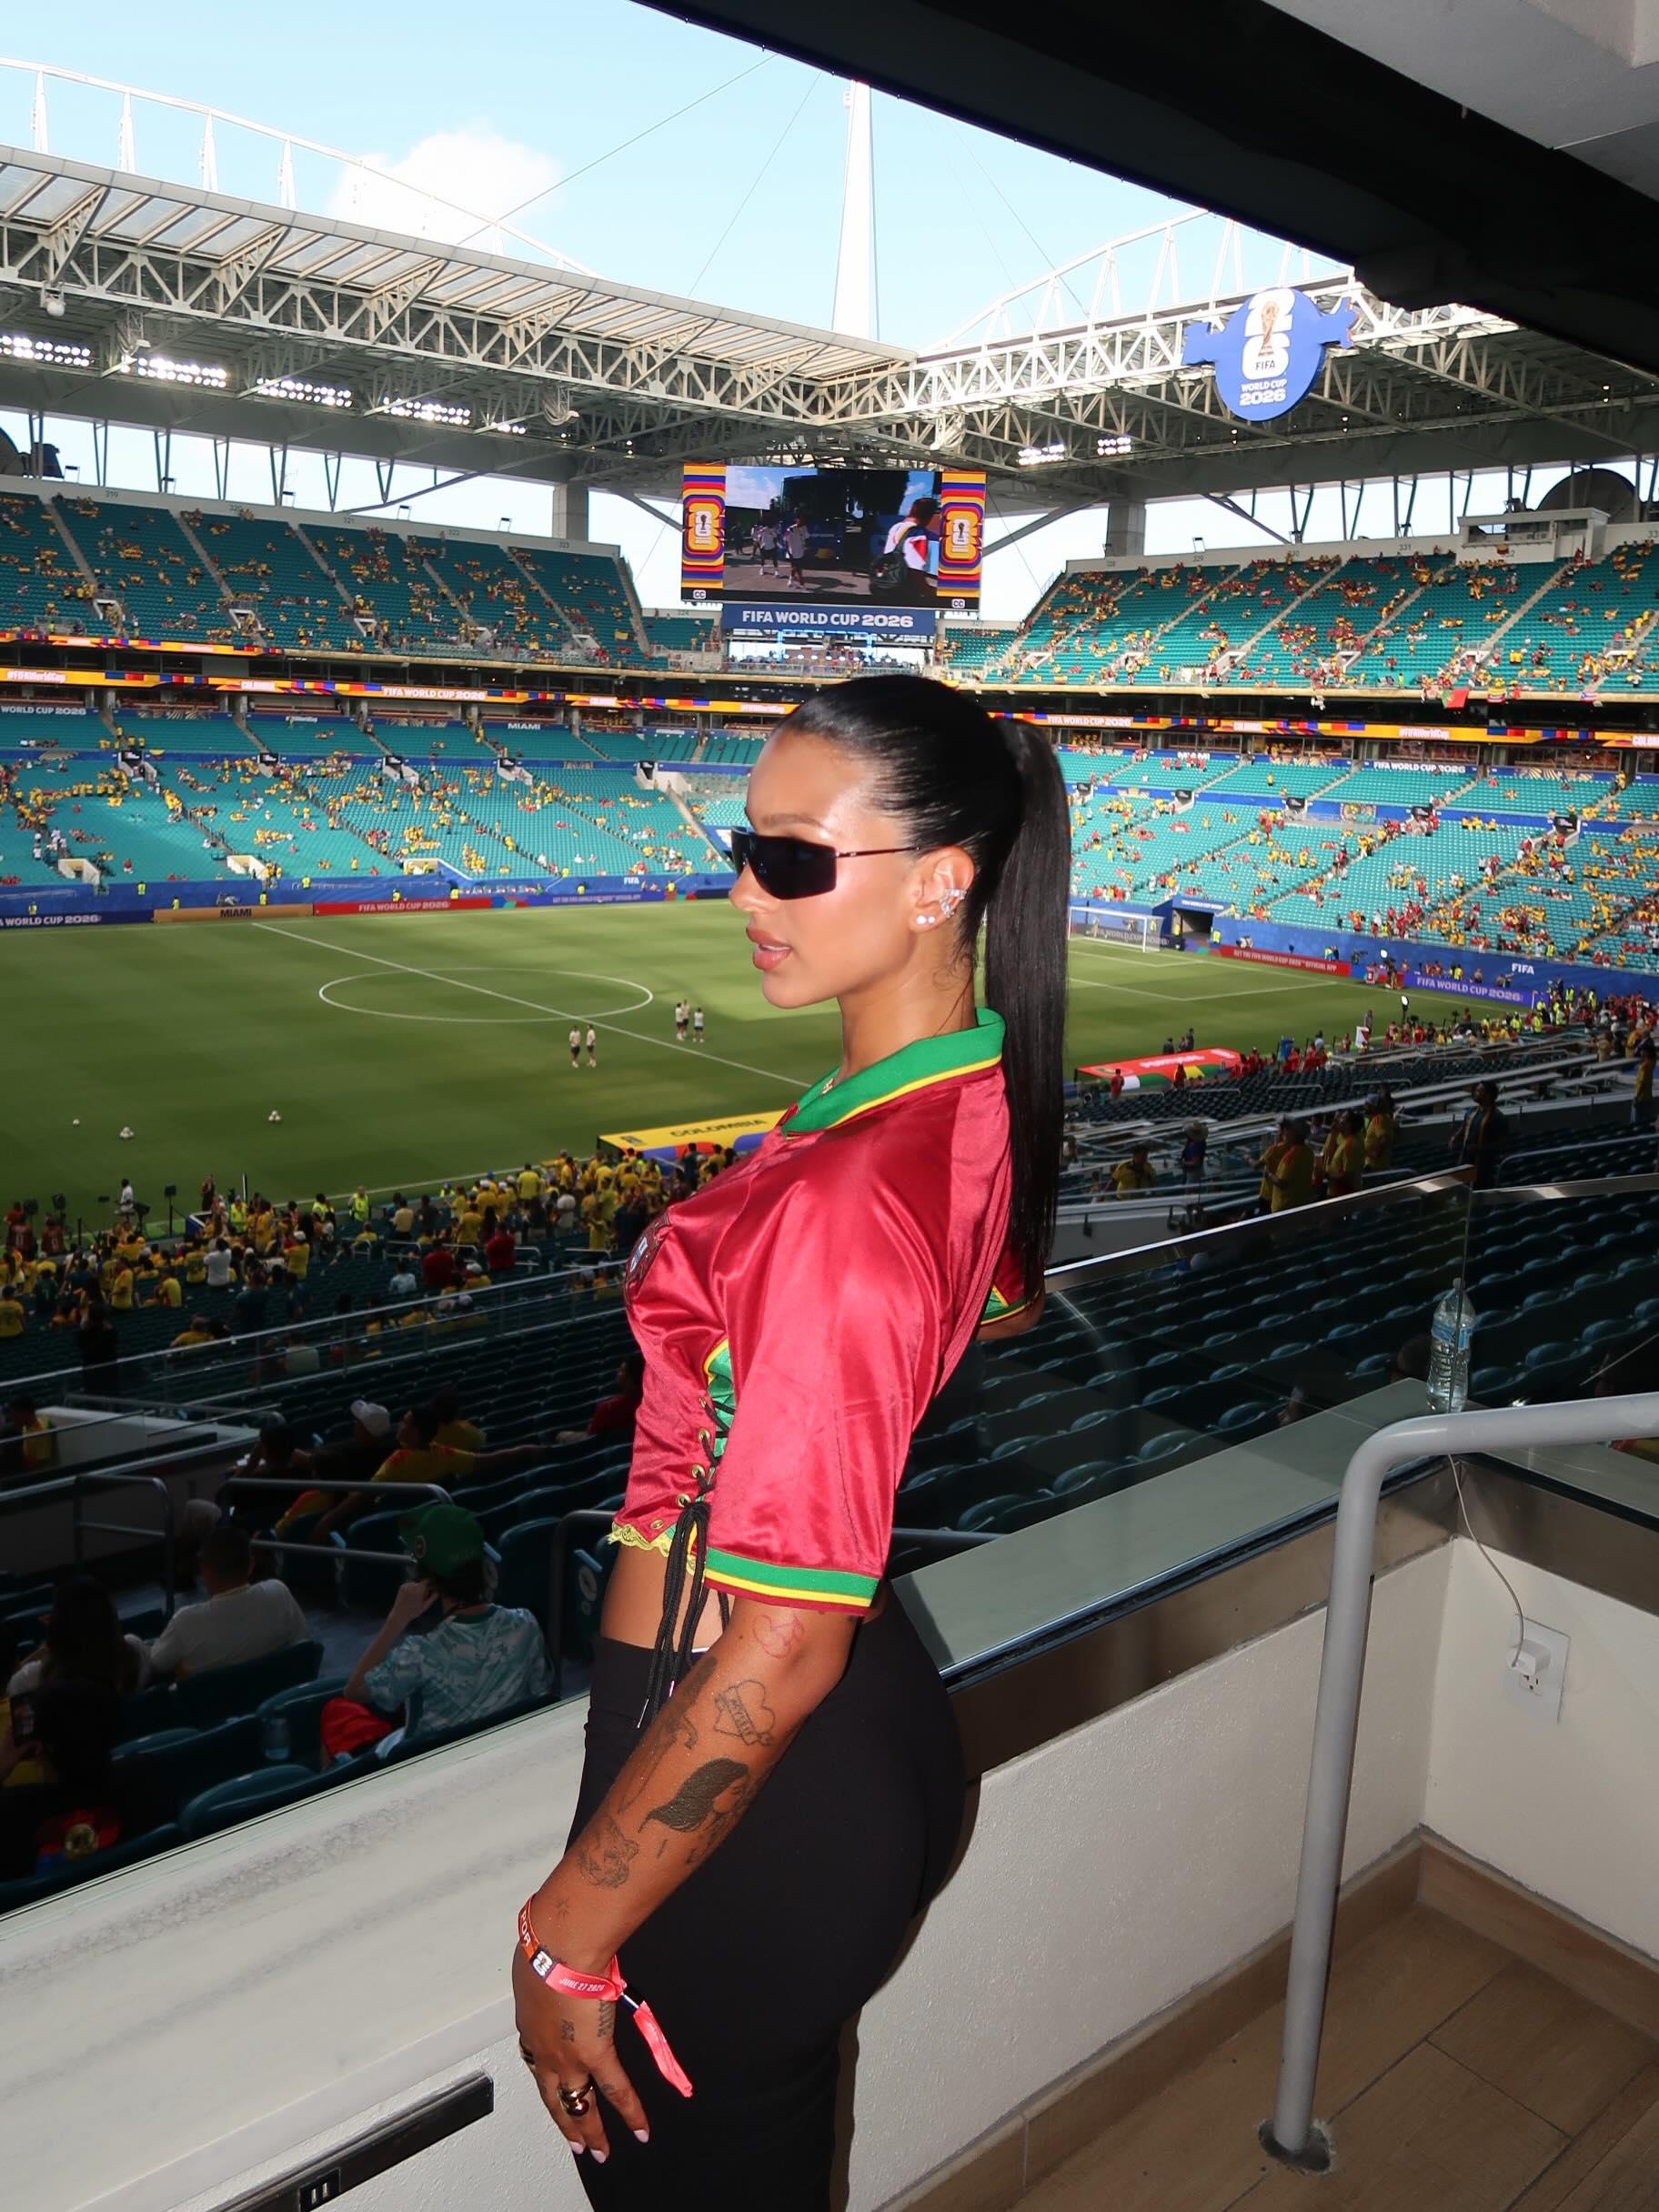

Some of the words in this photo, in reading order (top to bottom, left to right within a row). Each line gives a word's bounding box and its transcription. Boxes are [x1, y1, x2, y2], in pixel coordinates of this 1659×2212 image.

[1255, 360, 1275, 370] FIFA
[1241, 381, 1270, 392] WORLD
[1270, 378, 1287, 388] CUP
[1239, 389, 1287, 407] 2026
[742, 610, 772, 623] FIFA
[775, 611, 828, 625] WORLD
[833, 613, 860, 626] CUP
[861, 614, 914, 628] 2026
[383, 687, 407, 698] FIFA
[407, 689, 437, 699] WORLD
[437, 689, 455, 699] CUP
[455, 690, 487, 700] 2026
[1, 705, 35, 714] WORLD
[55, 707, 86, 716] 2026
[1063, 716, 1090, 725] WORLD
[1090, 717, 1105, 726] CUP
[1373, 761, 1390, 769] FIFA
[1392, 763, 1419, 771] WORLD
[1420, 764, 1437, 772] CUP
[624, 877, 639, 885] FIFA
[358, 903, 376, 912] FIFA
[377, 903, 405, 911] WORLD
[407, 901, 422, 910] CUP
[422, 900, 448, 910] 2026
[219, 909, 252, 918] MIAMI
[5, 915, 42, 926] WORLD
[44, 915, 63, 925] CUP
[64, 914, 99, 924] 2026
[1512, 962, 1535, 976] FIFA
[1416, 977, 1435, 989] FIFA
[1437, 980, 1469, 994] WORLD
[1470, 985, 1488, 996] CUP
[1488, 989, 1521, 1001] 2026
[519, 1912, 532, 1948] POR
[560, 1976, 578, 1991] JUNE
[578, 1983, 588, 1992] 27
